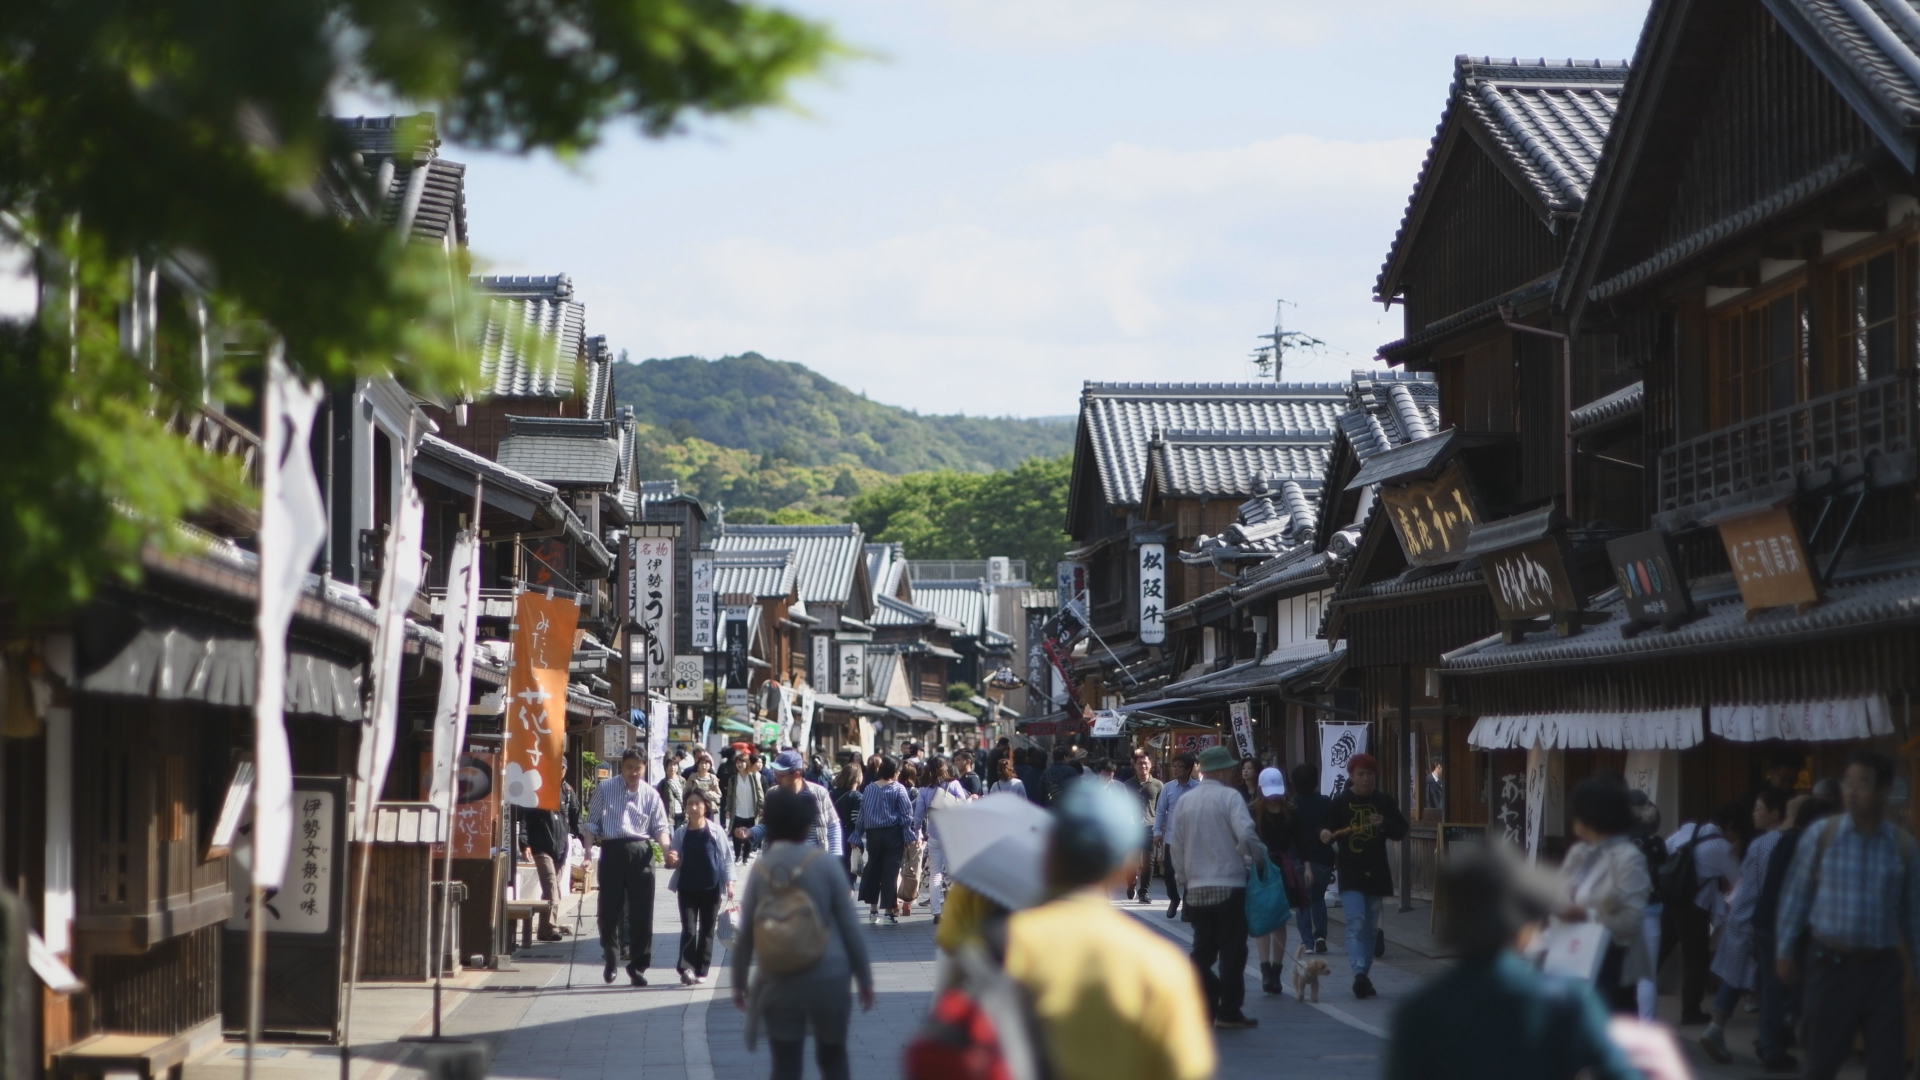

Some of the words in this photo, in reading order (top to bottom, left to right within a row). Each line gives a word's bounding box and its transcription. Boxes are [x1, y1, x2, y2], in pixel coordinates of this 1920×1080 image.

[640, 542, 668, 557] 名物
[695, 593, 710, 643] 岡七酒店
[1142, 551, 1164, 625] 松阪牛
[531, 610, 550, 681] みたらし
[517, 686, 552, 767] 花子
[457, 806, 478, 854] 花子
[1497, 774, 1522, 846] あわび
[300, 798, 322, 917] 伊勢女衆の味
